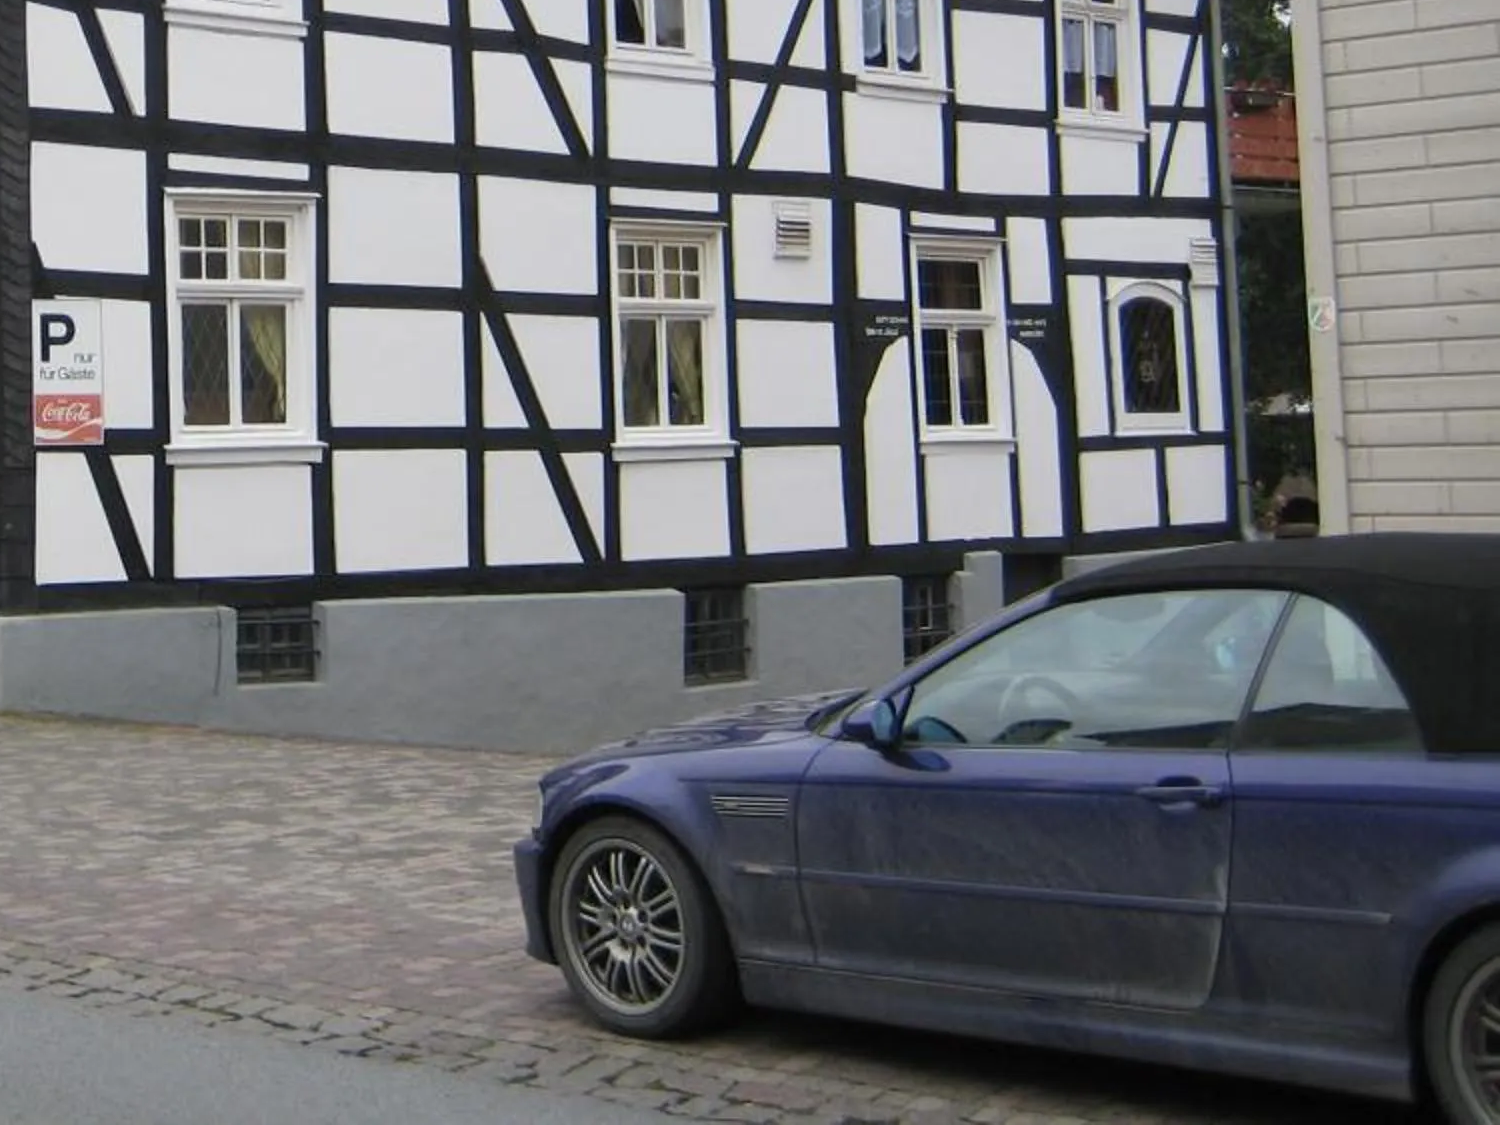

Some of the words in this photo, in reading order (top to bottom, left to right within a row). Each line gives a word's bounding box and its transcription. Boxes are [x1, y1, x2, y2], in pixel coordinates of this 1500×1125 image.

[40, 313, 76, 362] P
[73, 353, 95, 364] nur
[40, 366, 56, 380] für
[58, 366, 95, 380] Gäste
